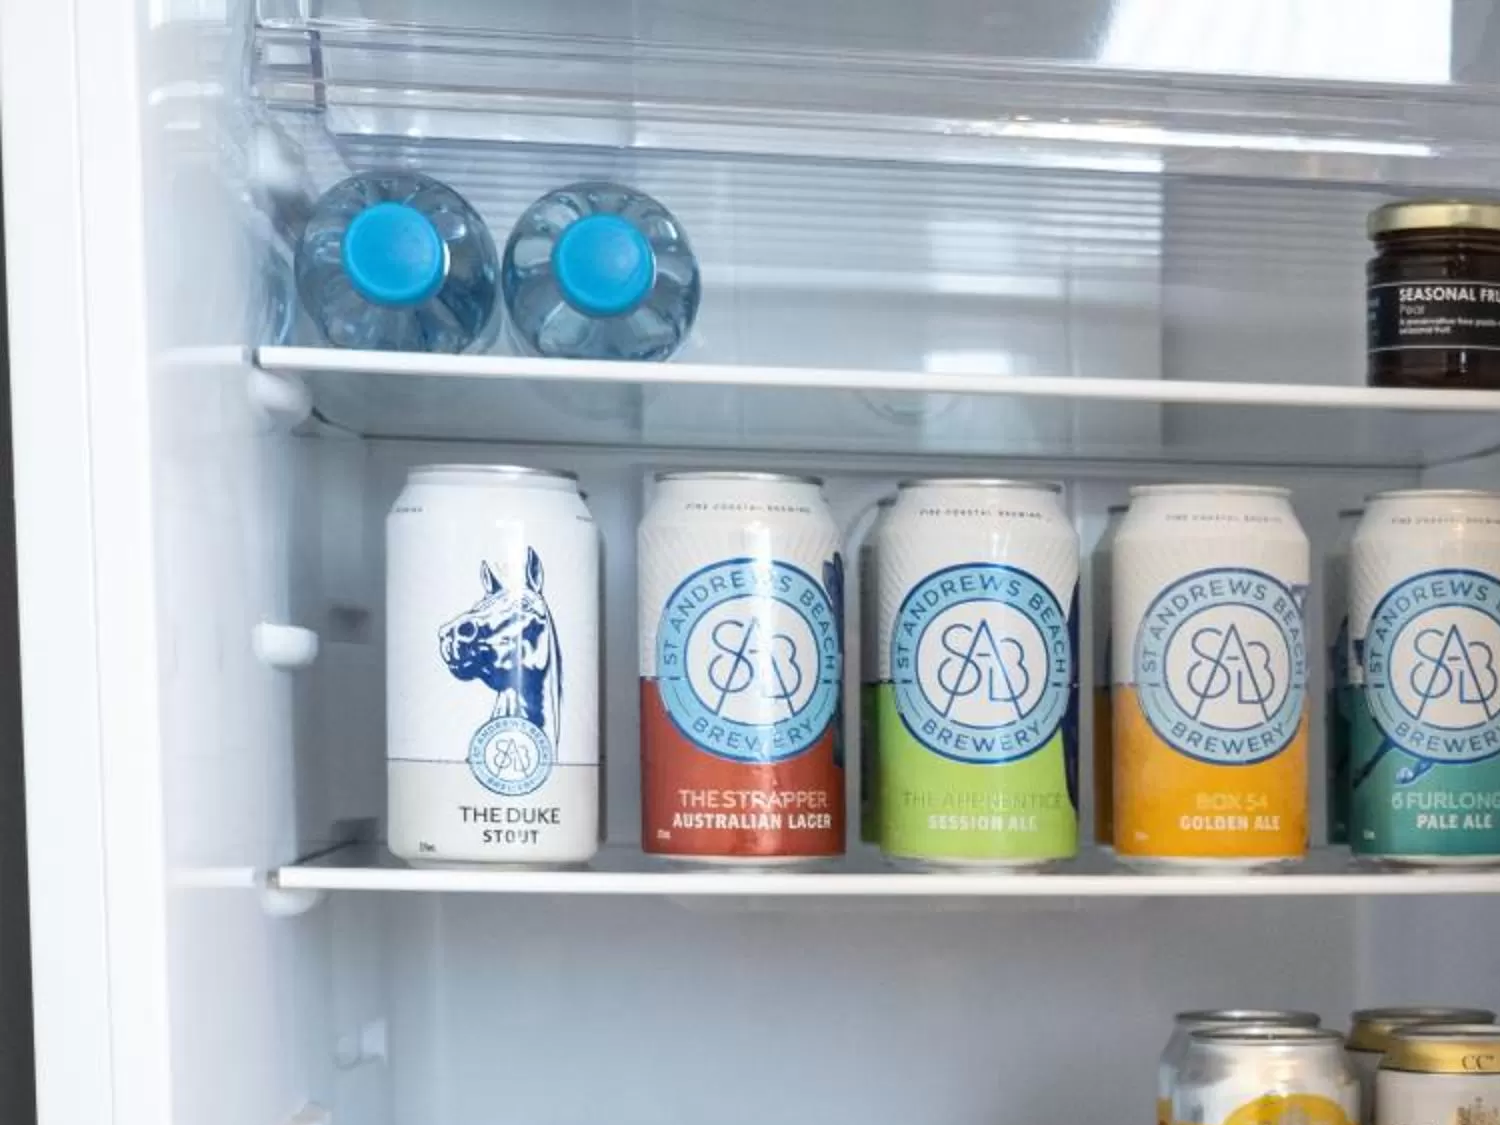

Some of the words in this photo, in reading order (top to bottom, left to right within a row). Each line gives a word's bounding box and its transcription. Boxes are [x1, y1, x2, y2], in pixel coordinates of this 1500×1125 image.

[1399, 287, 1476, 301] SEASONAL
[903, 574, 1022, 636] ANDREWS
[1375, 580, 1489, 642] ANDREWS
[800, 589, 836, 671] BEACH
[1028, 593, 1066, 674] BEACH
[1150, 577, 1268, 641] ANDREWS
[1272, 596, 1303, 674] BEACH
[898, 646, 909, 669] ST
[922, 718, 1041, 752] BREWERY
[1171, 721, 1285, 755] BREWERY
[677, 789, 721, 808] THE
[722, 790, 828, 810] STRAPPER
[1196, 791, 1243, 811] BOX
[1246, 792, 1269, 811] 54
[1391, 792, 1404, 810] 6
[459, 806, 502, 823] THE
[507, 807, 561, 824] DUKE
[673, 812, 781, 830] AUSTRALIAN
[788, 814, 833, 830] LAGER
[928, 815, 1004, 831] SESSION
[1008, 815, 1039, 832] ALE
[1179, 815, 1248, 831] GOLDEN
[1254, 815, 1281, 831] ALE
[1416, 814, 1459, 830] PALE
[1463, 814, 1494, 830] ALE
[483, 829, 539, 844] STOUT
